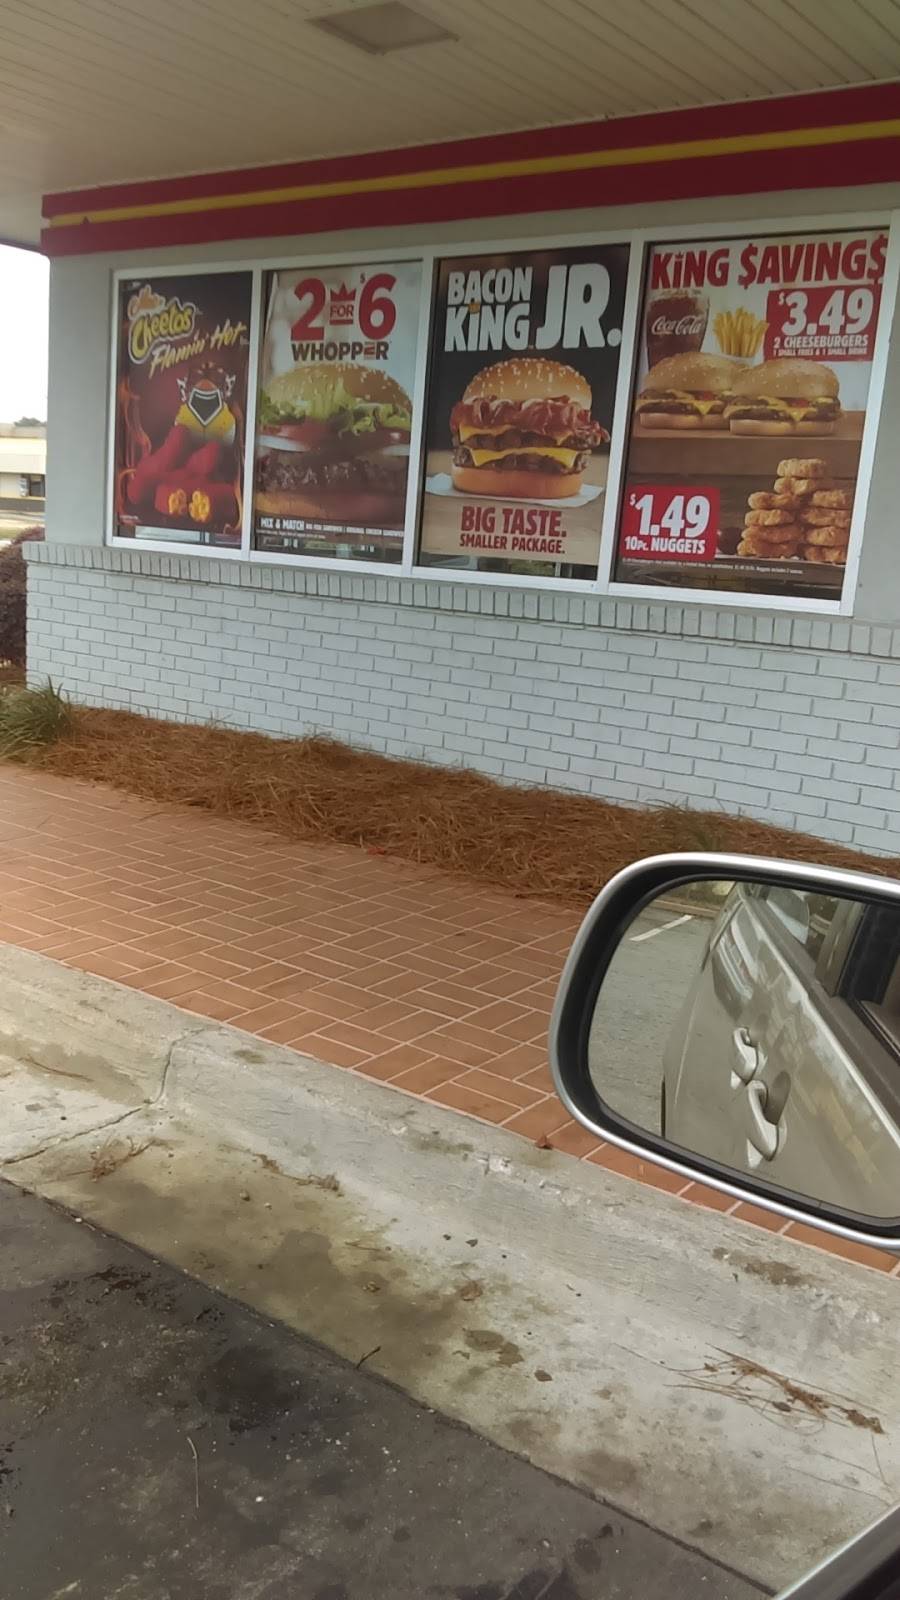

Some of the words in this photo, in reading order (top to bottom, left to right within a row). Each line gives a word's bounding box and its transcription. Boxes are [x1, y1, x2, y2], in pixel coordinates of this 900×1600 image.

[447, 266, 533, 306] BACON
[651, 248, 730, 290] KING
[290, 278, 326, 340] 2
[329, 304, 354, 318] FOR
[535, 263, 622, 349] JR.
[779, 288, 874, 336] $3.49
[130, 300, 195, 361] Cheetos
[210, 318, 247, 349] Hot
[445, 303, 531, 352] KING
[773, 336, 781, 349] 2
[784, 334, 869, 349] CHEESEBURGERS
[291, 341, 389, 361] WHOPPER
[261, 517, 273, 529] MIX
[275, 518, 281, 529] &
[461, 506, 496, 533] BIG
[502, 508, 567, 538] TASTE.
[629, 493, 711, 538] $1.49
[459, 533, 507, 550] SMALLER
[511, 537, 565, 554] PACKAGE.
[651, 537, 706, 555] NUGGETS
